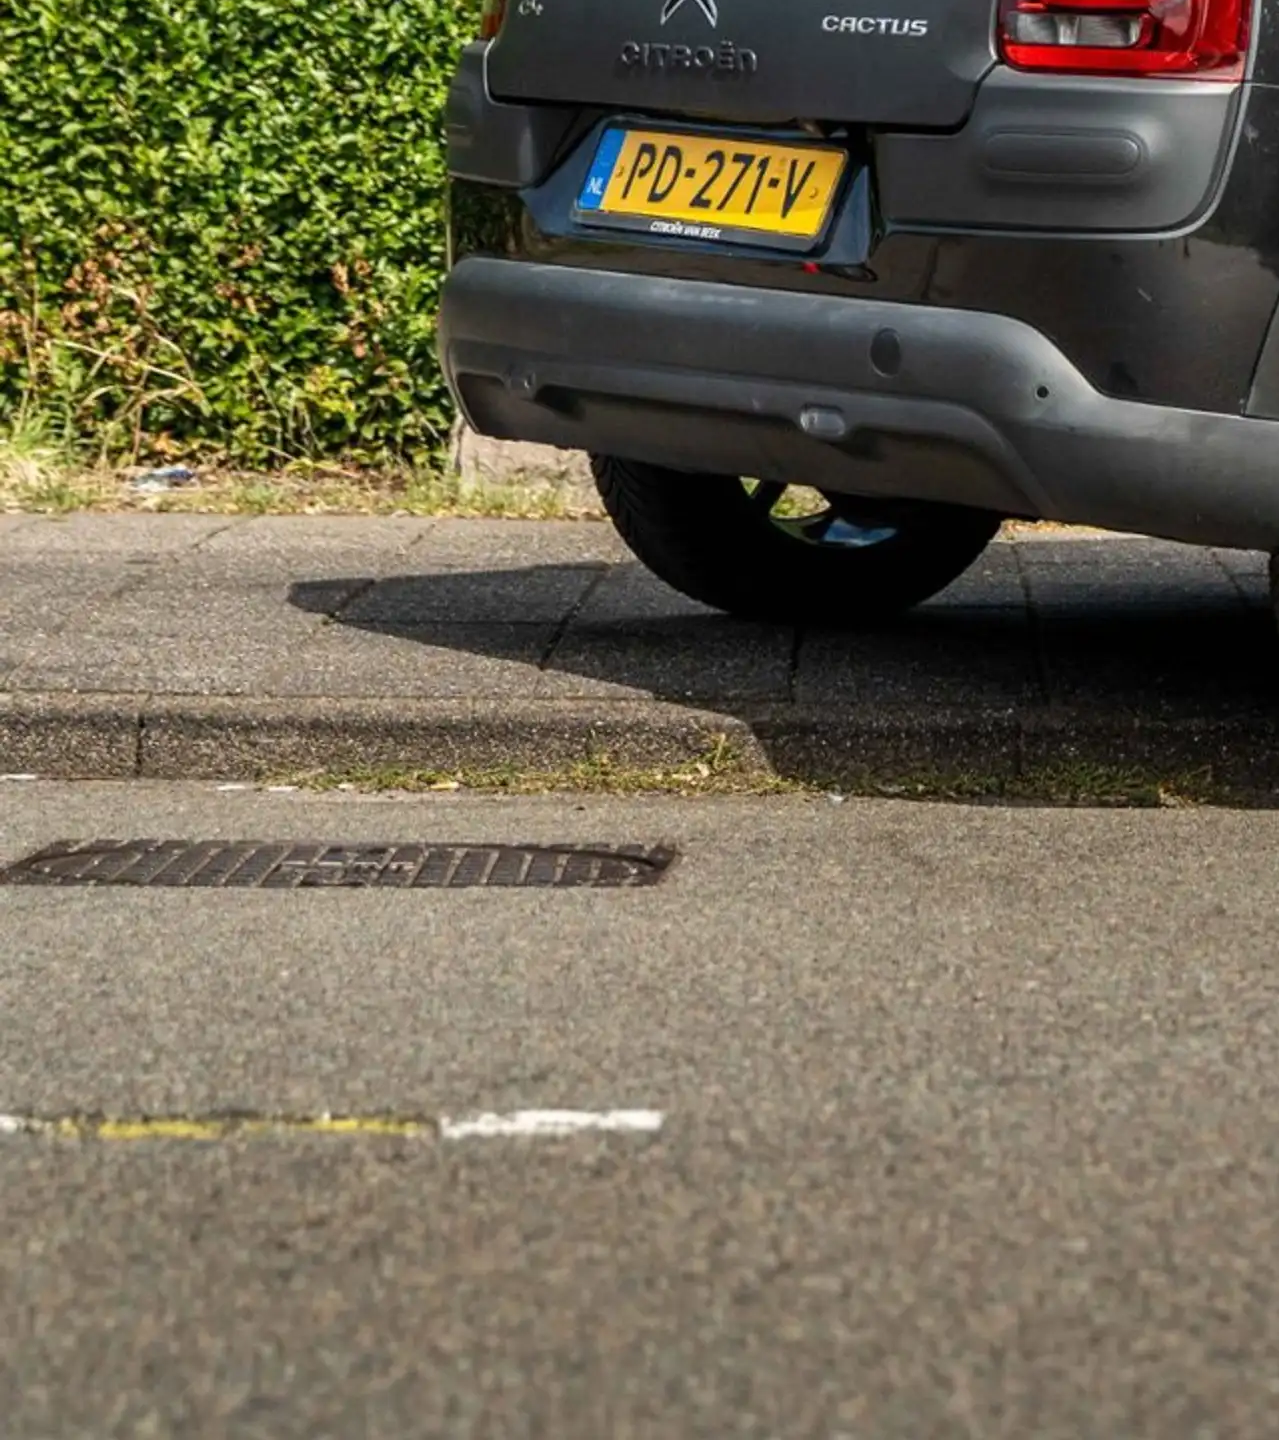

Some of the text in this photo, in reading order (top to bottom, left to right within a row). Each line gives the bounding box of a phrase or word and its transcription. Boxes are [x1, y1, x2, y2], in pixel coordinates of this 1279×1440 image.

[821, 14, 928, 37] CACTUS
[586, 177, 604, 195] NL
[621, 142, 816, 219] PD-271-V
